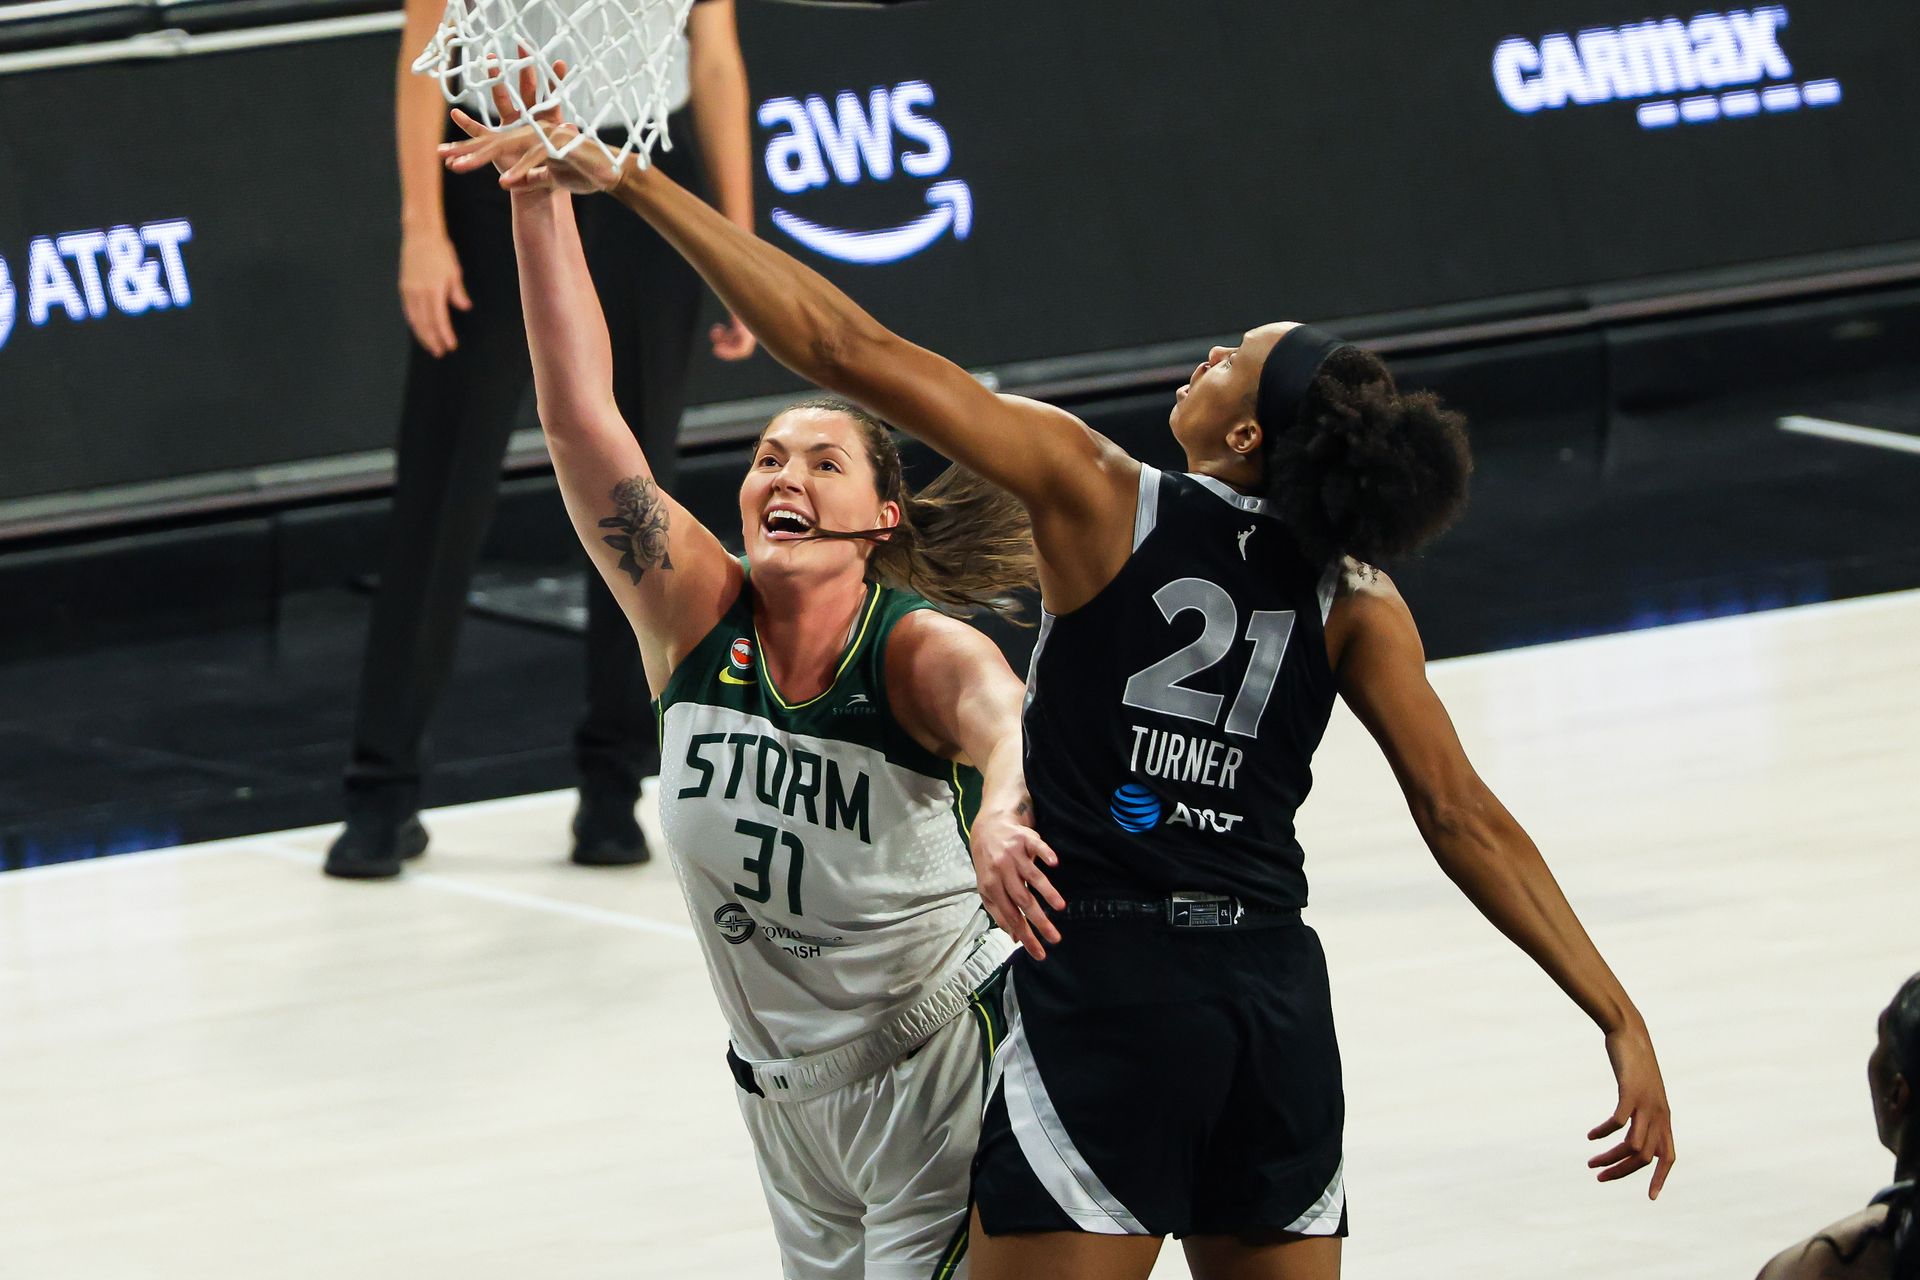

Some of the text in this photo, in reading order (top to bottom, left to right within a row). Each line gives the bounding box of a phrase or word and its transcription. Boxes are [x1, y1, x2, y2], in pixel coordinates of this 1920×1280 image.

[757, 80, 952, 194] aws
[28, 218, 193, 327] AT&T
[1122, 577, 1296, 739] 21
[677, 732, 871, 844] STORM
[1130, 725, 1244, 790] TURNER
[733, 818, 804, 917] 31
